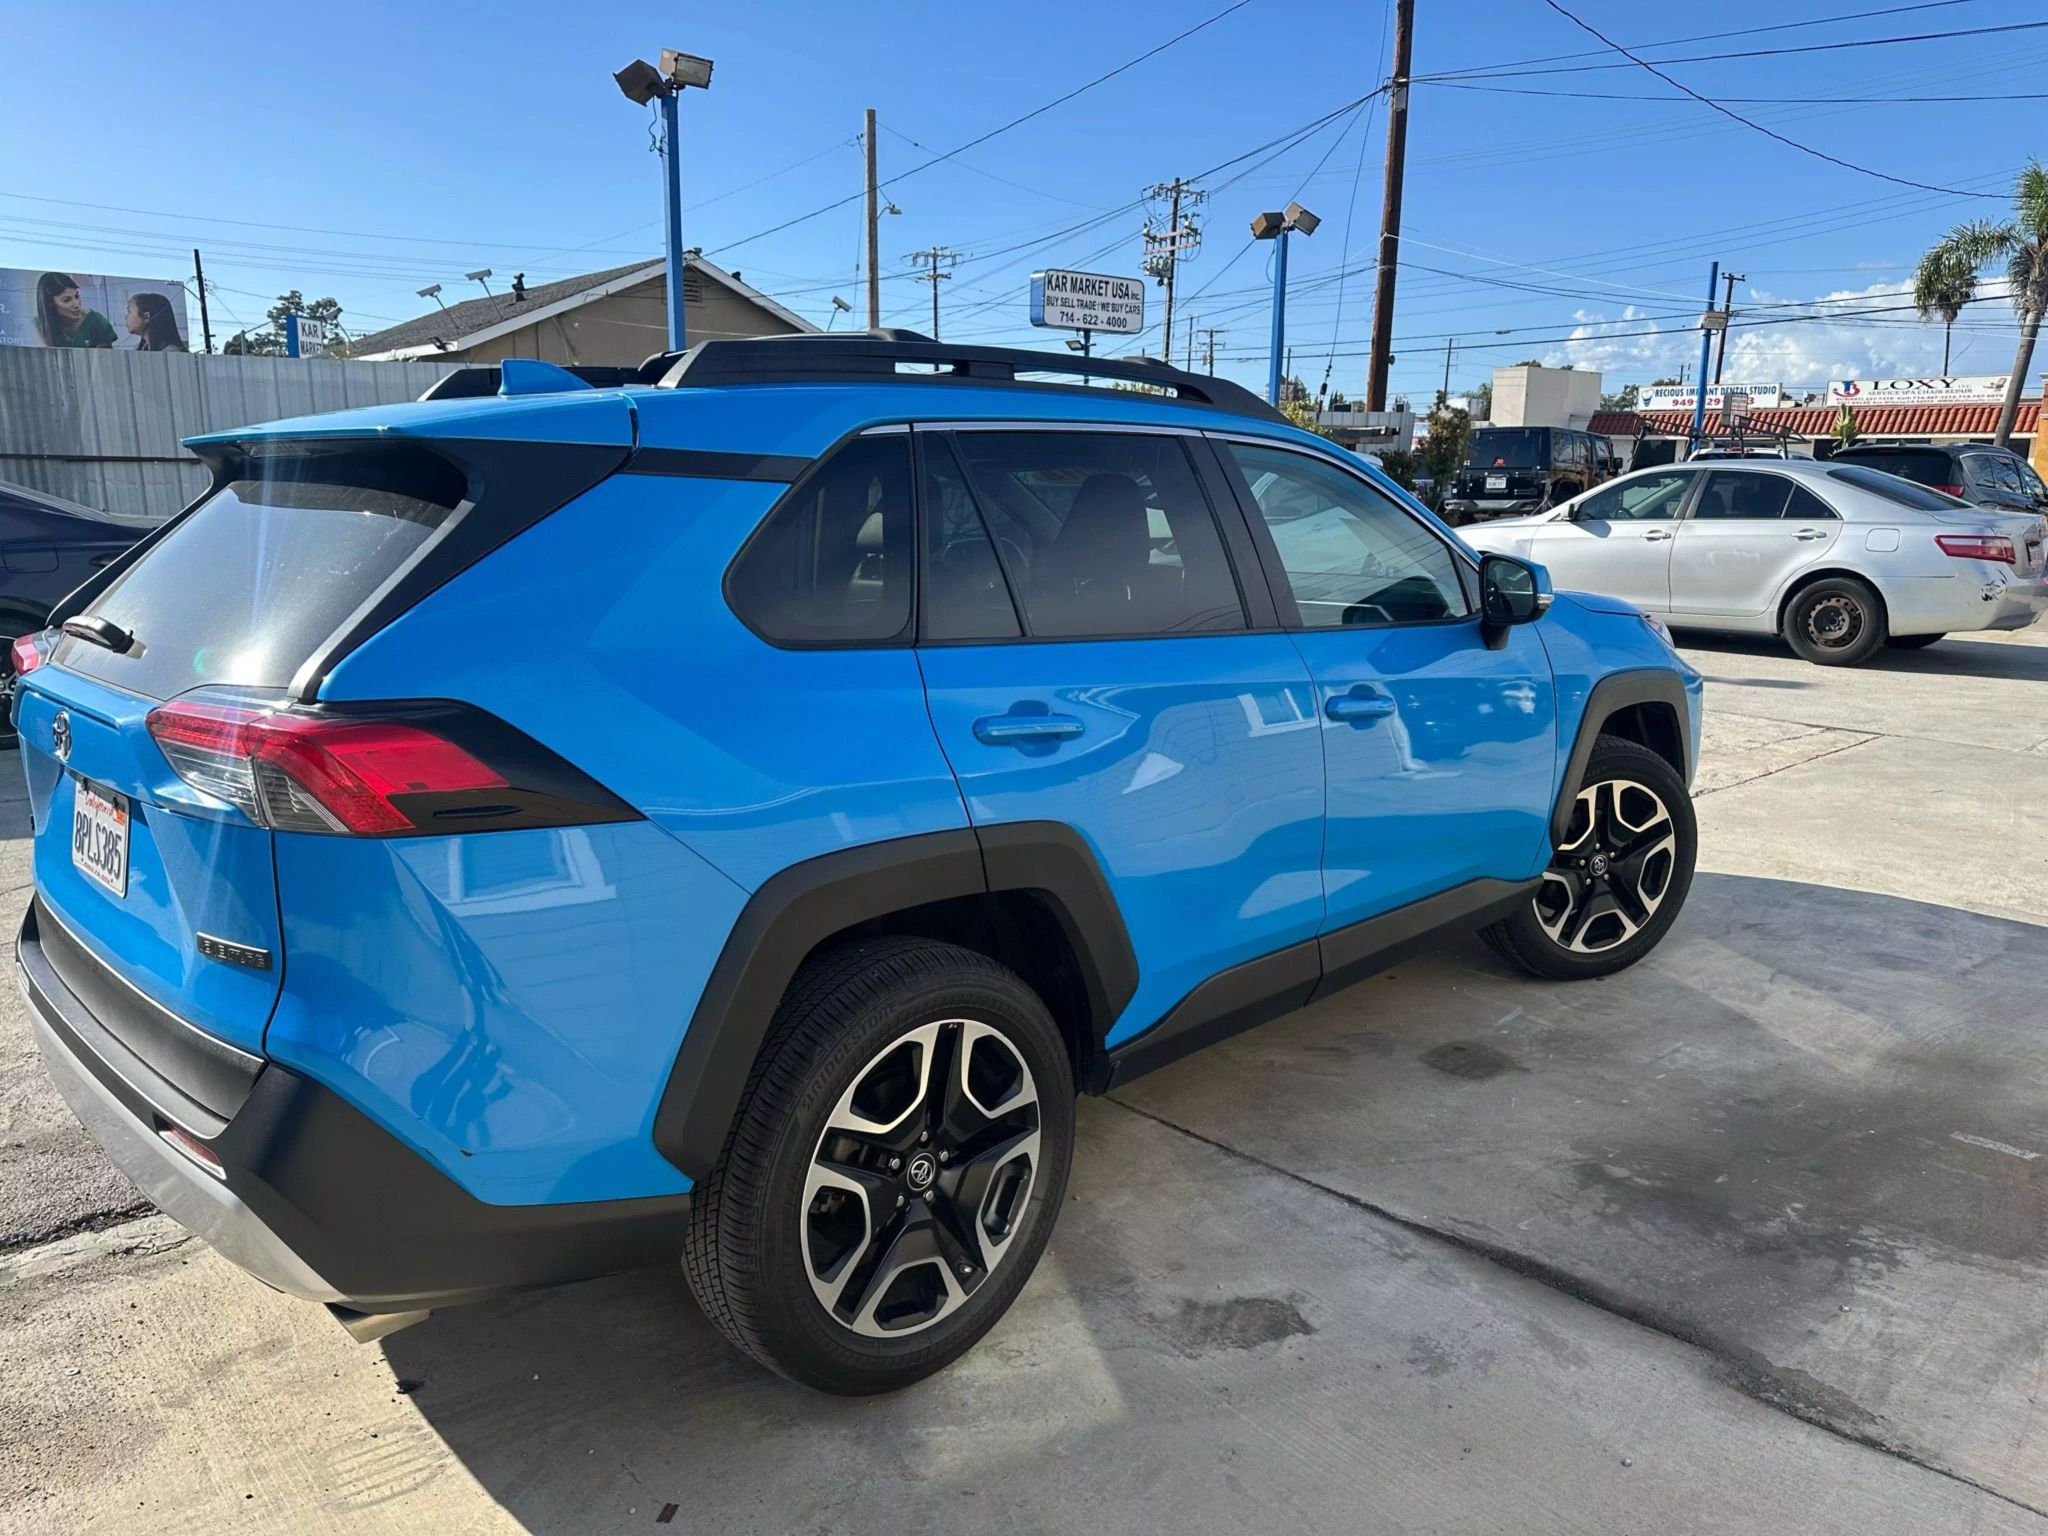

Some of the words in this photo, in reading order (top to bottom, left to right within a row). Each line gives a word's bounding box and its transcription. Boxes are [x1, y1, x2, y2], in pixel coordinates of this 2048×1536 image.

[1047, 274, 1068, 293] KAR
[1070, 276, 1109, 297] MARKET
[1112, 281, 1130, 300] USA
[1046, 295, 1058, 307] BUY
[1060, 297, 1075, 308] SELL
[1076, 299, 1096, 311] TRADE
[1100, 302, 1110, 313] WE
[1111, 303, 1125, 314] BUY
[1125, 304, 1141, 315] CARS
[301, 322, 319, 338] KAR
[1749, 385, 1778, 395] STUDIO
[1873, 379, 1958, 391] LOXY
[75, 810, 122, 880] 8PLS385
